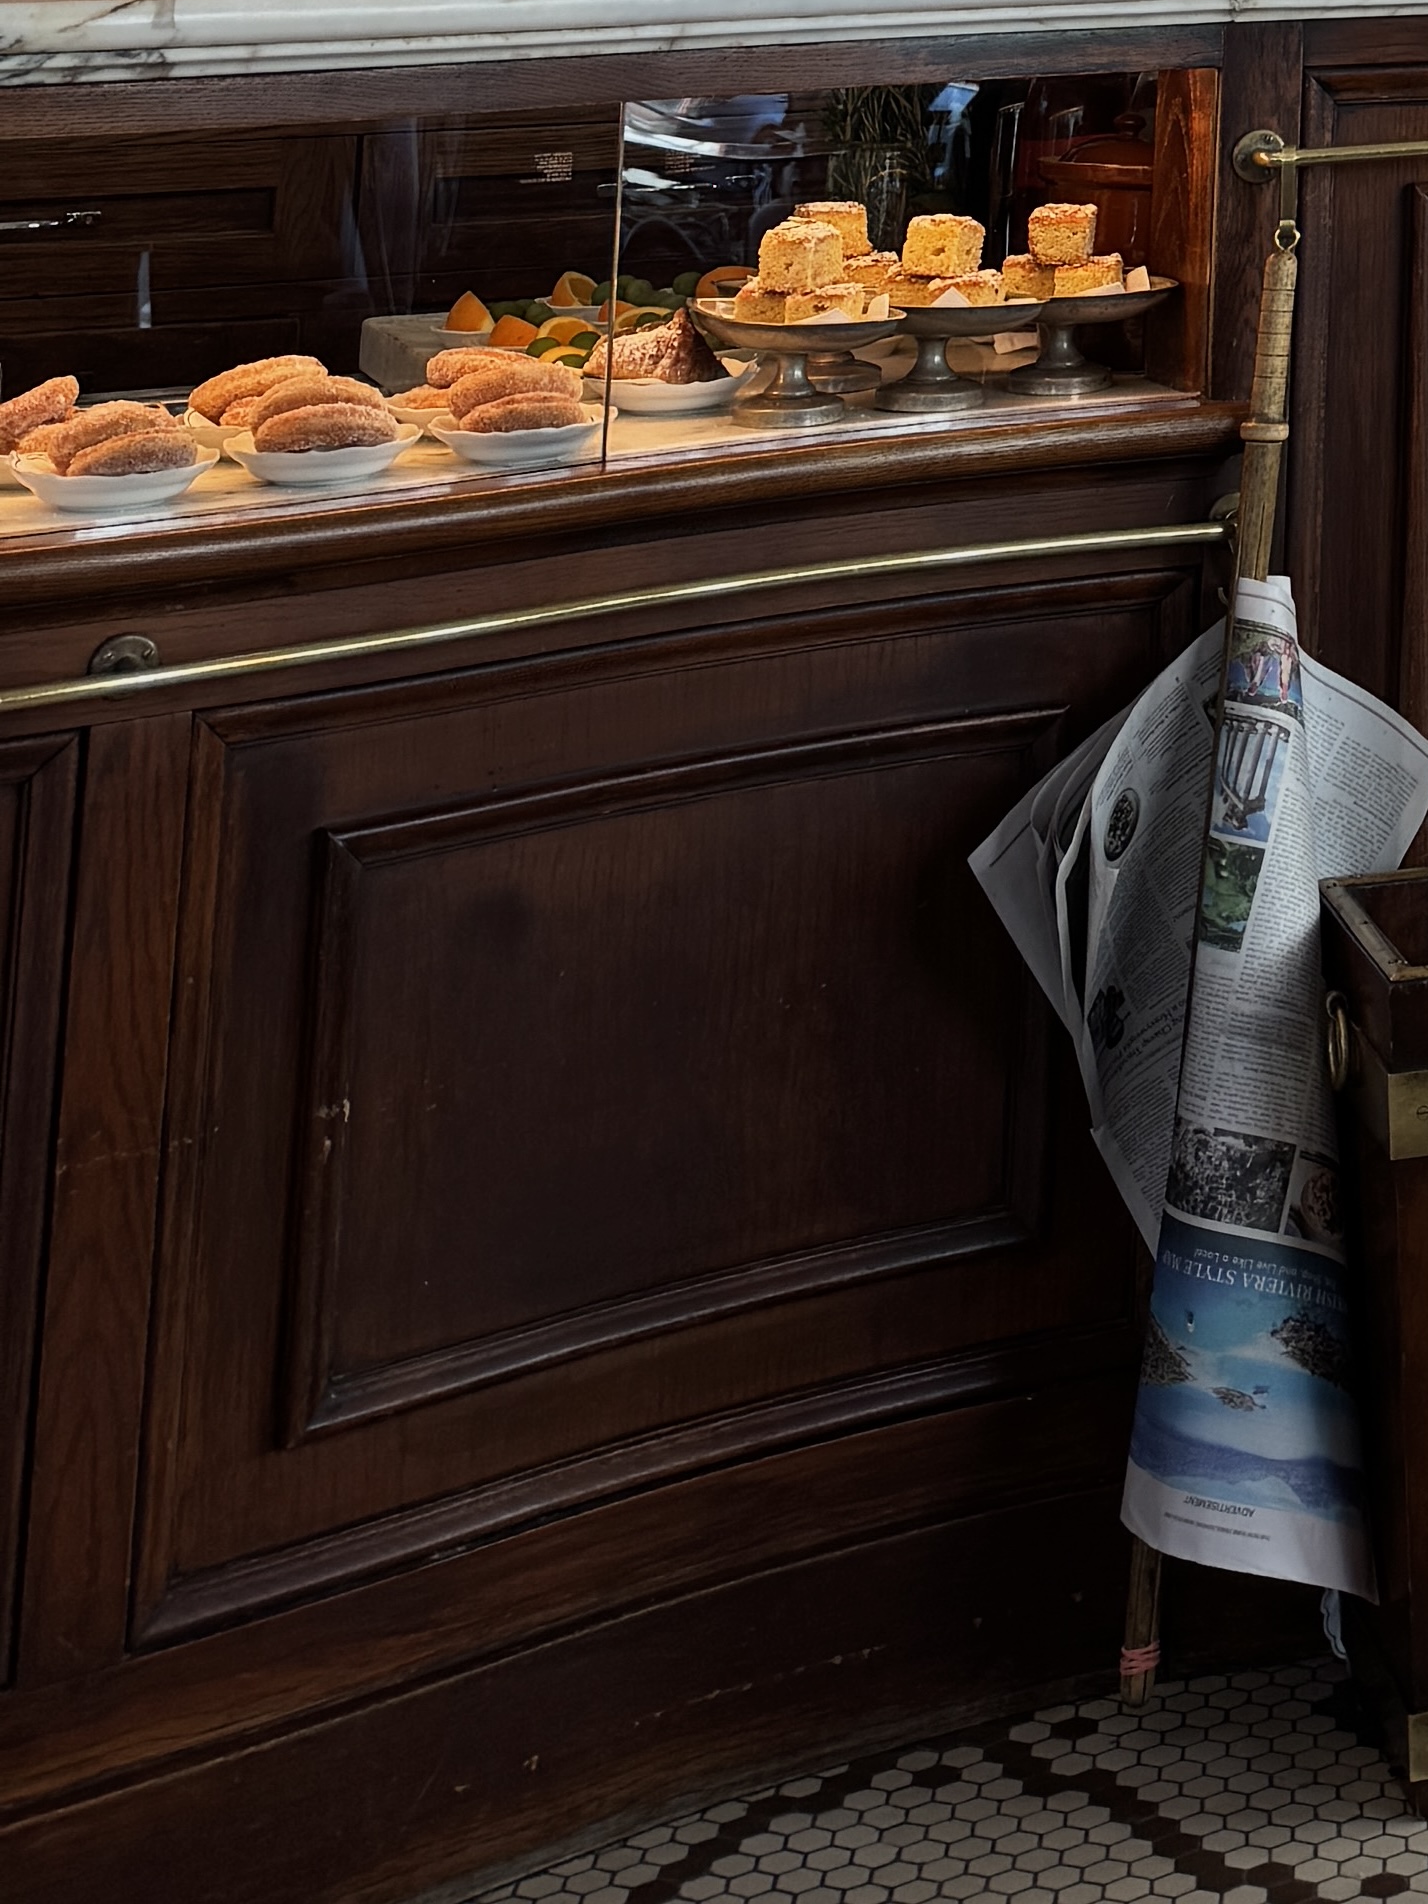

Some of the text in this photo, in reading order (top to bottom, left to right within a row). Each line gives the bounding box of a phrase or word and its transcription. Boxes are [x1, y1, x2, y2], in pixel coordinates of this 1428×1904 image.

[1184, 1259, 1238, 1287] STYLE
[1232, 1257, 1255, 1270] Like
[1256, 1261, 1278, 1275] Live
[1242, 1272, 1312, 1302] RIVIERA
[1183, 1495, 1256, 1518] ADVERTISEMENT
